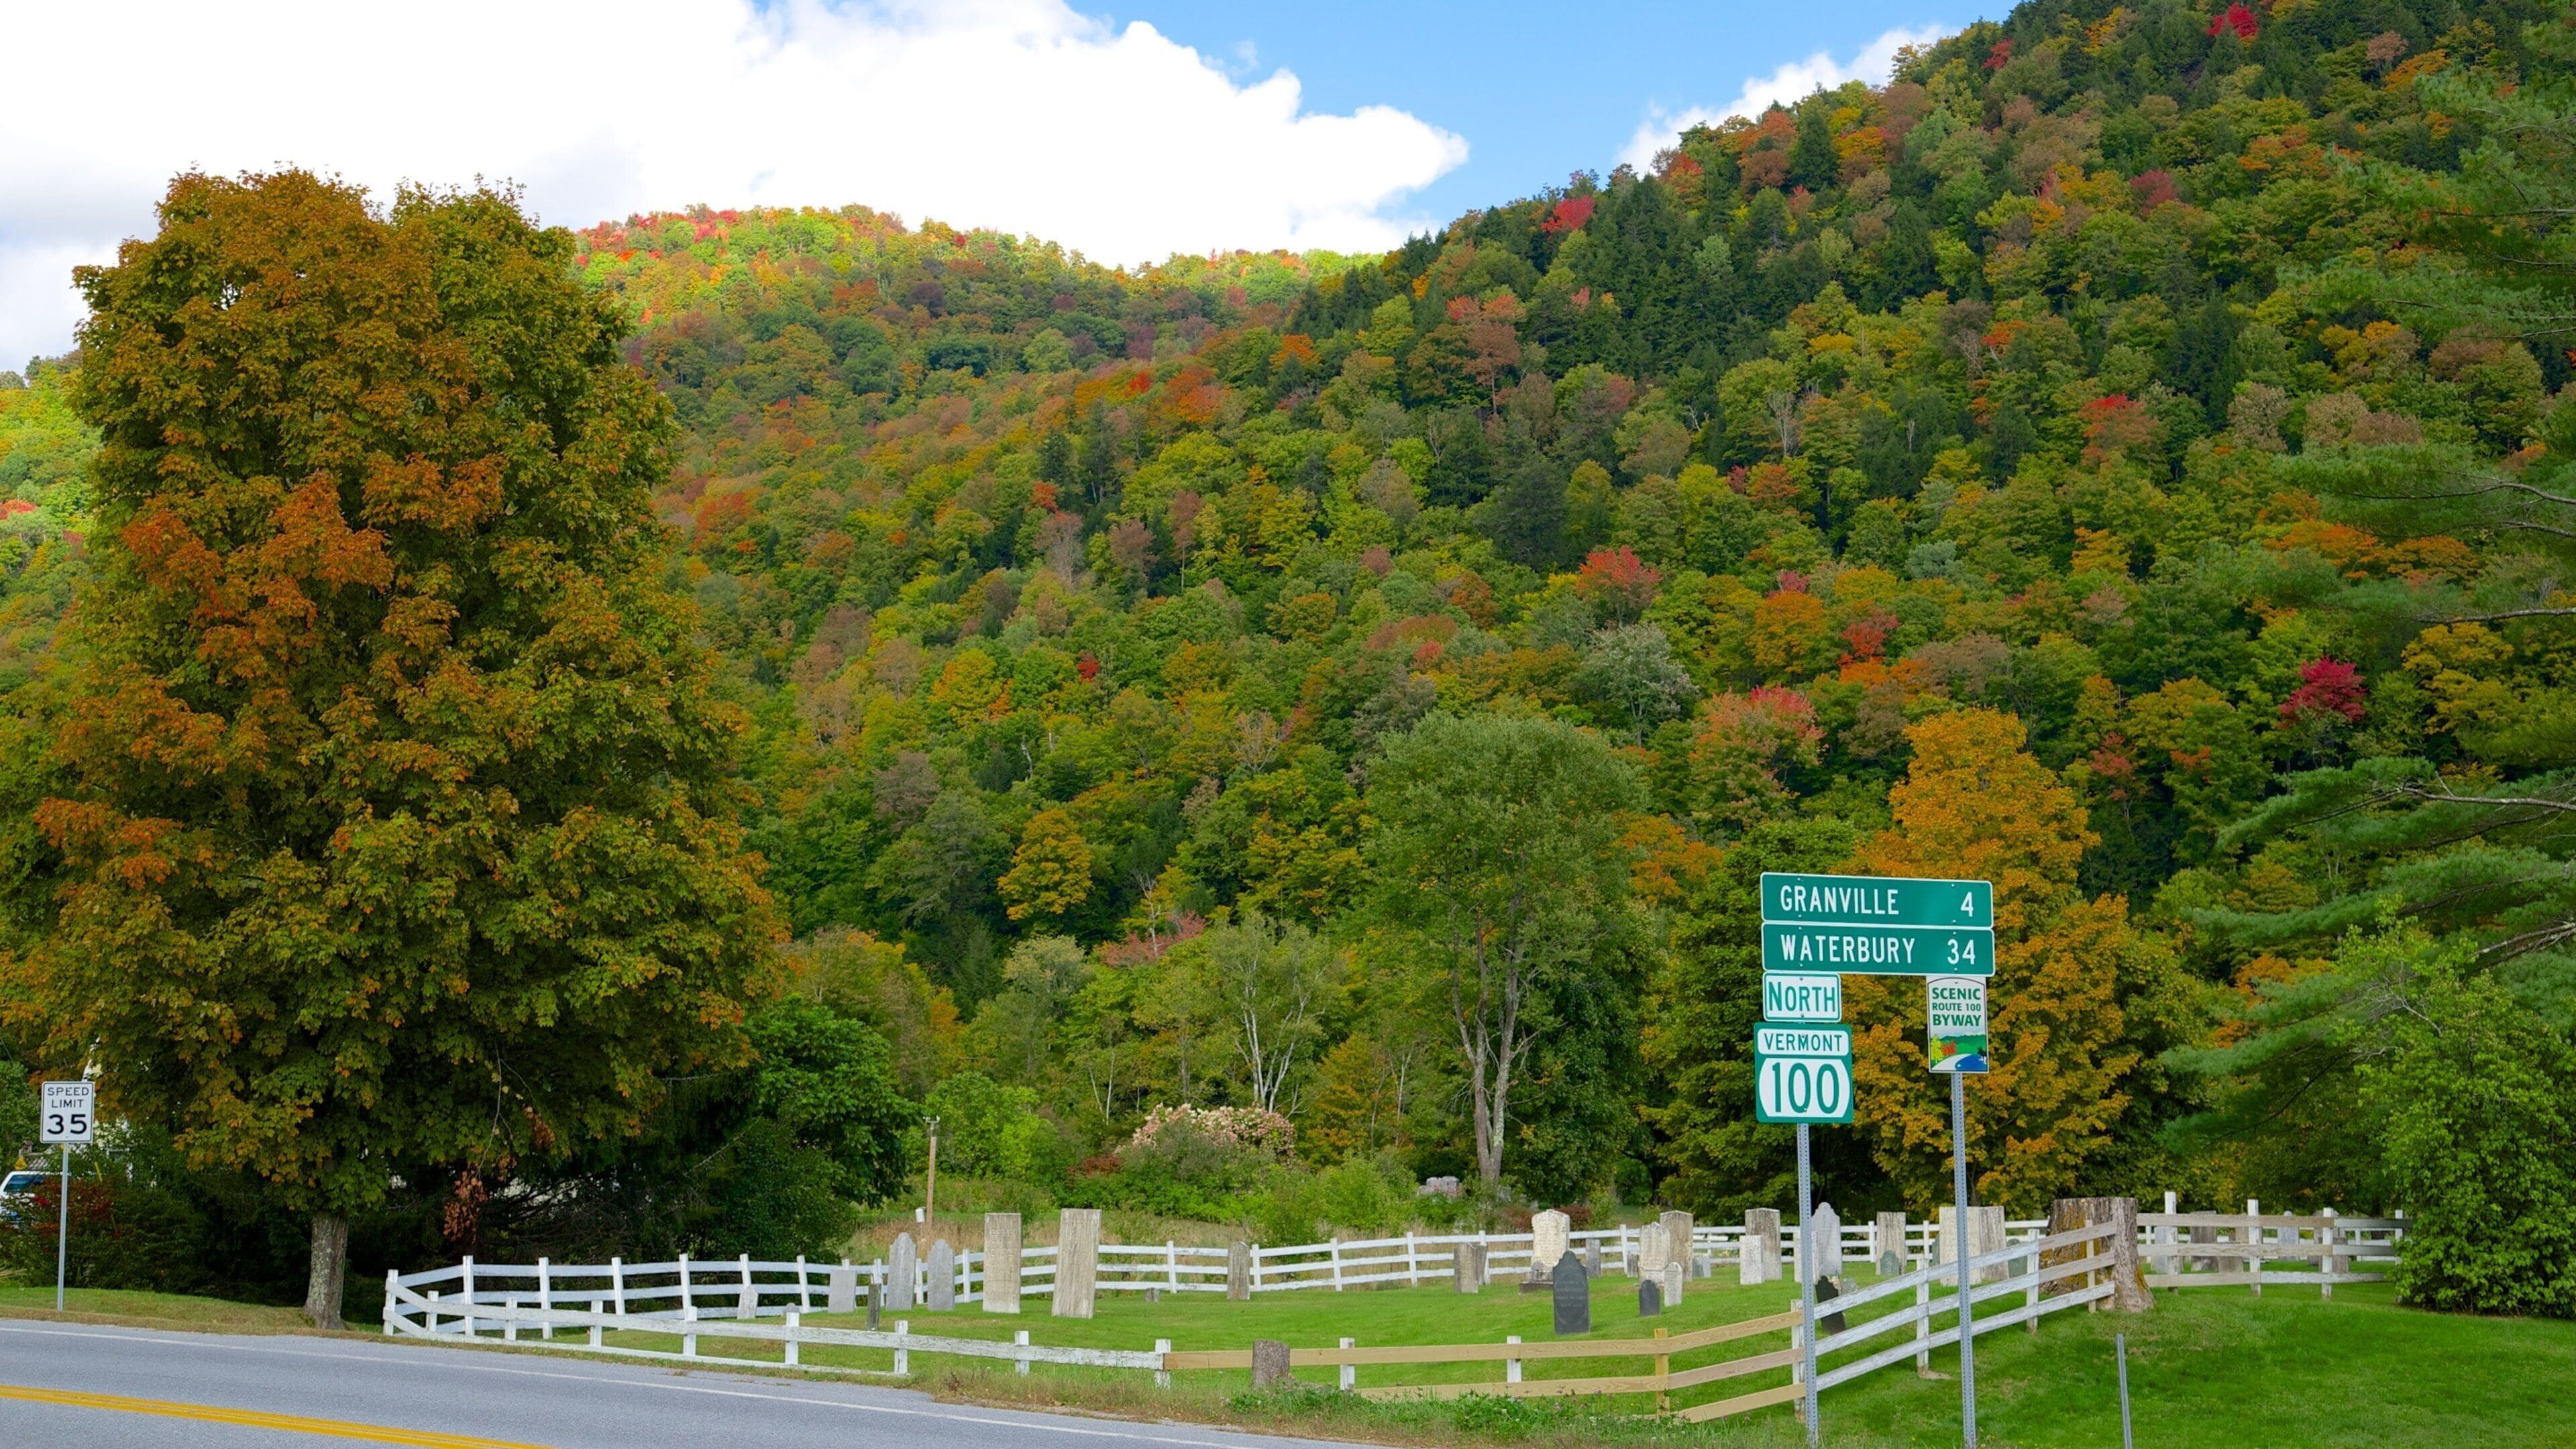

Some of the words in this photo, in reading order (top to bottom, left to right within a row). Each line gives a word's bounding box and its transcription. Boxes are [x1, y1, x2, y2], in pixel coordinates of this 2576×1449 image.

[1780, 885, 1899, 915] GRANVILLE
[1960, 892, 1974, 917] 4
[1780, 934, 1916, 963] WATERBURY
[1947, 938, 1976, 965] 34
[1768, 981, 1836, 1012] NORTH
[1932, 987, 1981, 1000] SCENIC
[1932, 1002, 1962, 1012] ROUTE
[1966, 1003, 1982, 1012] 100
[1933, 1014, 1982, 1026] BYWAY
[1764, 1032, 1843, 1052] VERMONT
[48, 1087, 89, 1096] SPEED
[1772, 1061, 1840, 1114] 100
[52, 1099, 84, 1108] LIMIT
[47, 1114, 87, 1134] 35
